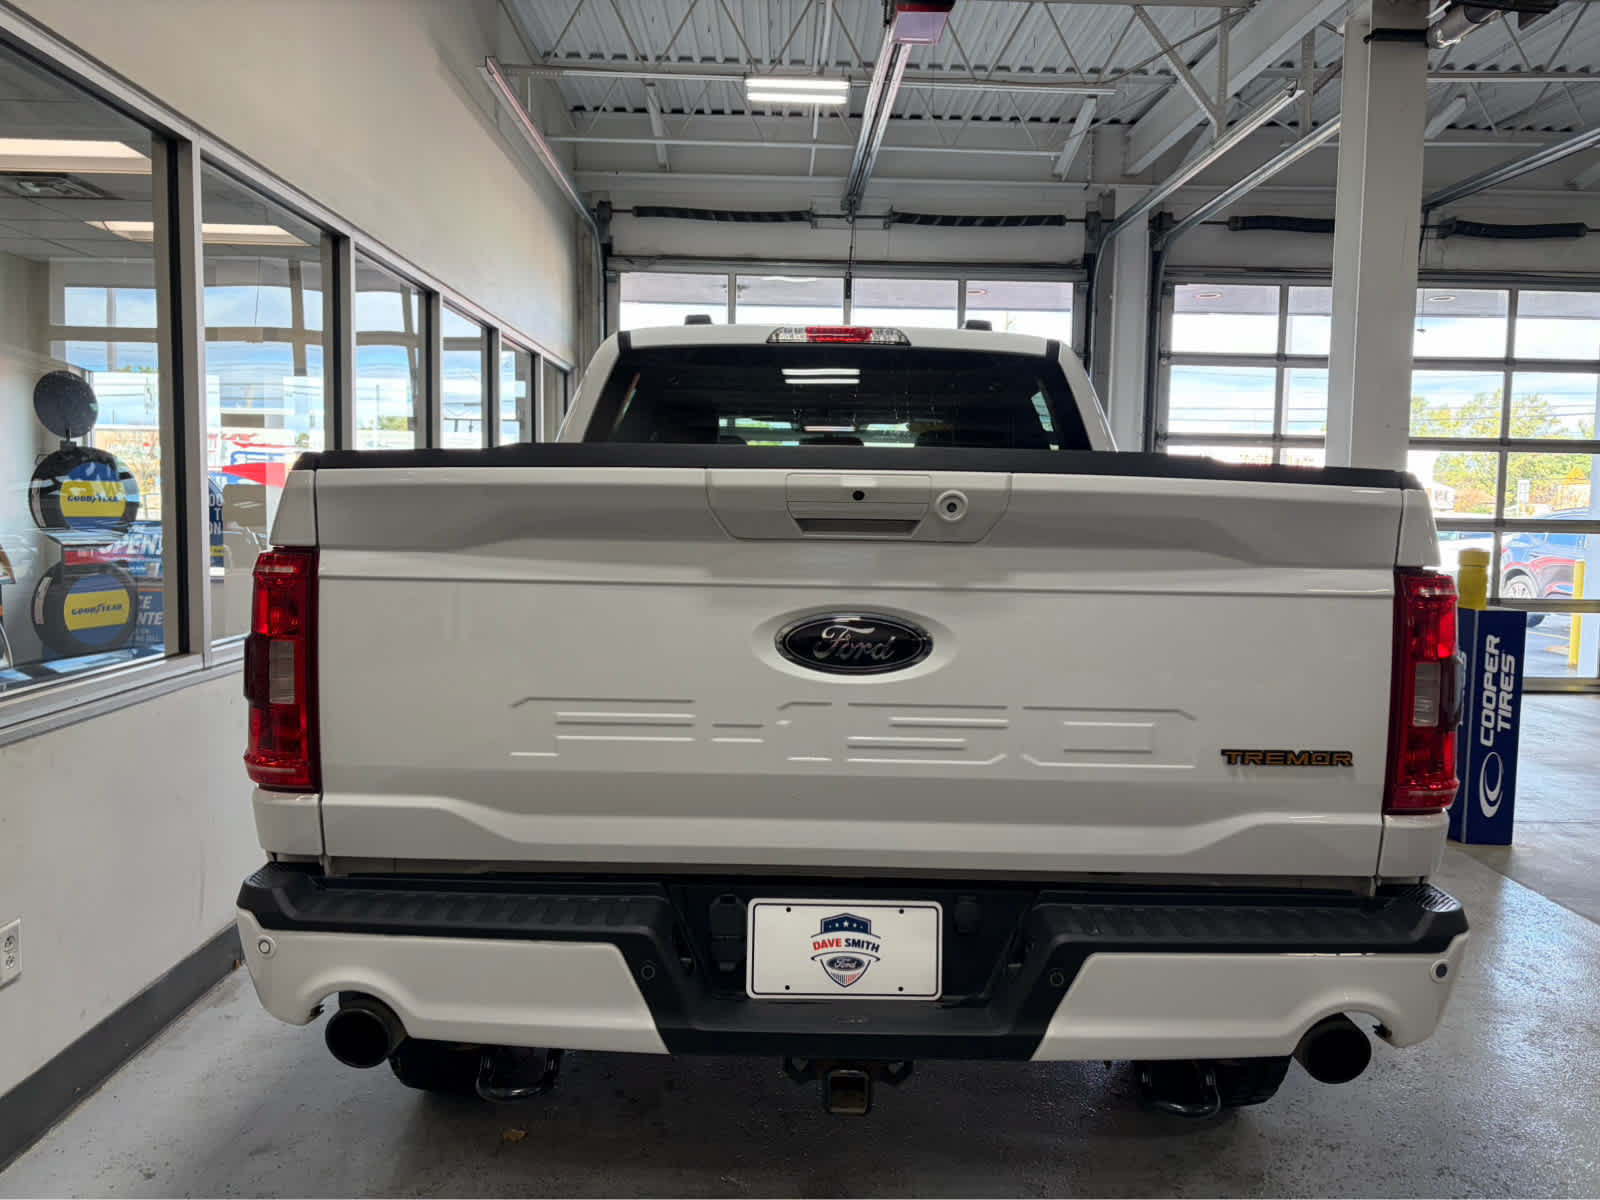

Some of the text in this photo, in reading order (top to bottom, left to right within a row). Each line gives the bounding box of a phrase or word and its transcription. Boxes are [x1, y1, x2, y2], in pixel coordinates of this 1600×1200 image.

[67, 494, 119, 504] GOODYEAR
[71, 602, 123, 616] GOODYEAR
[813, 624, 897, 660] Ford
[1480, 634, 1500, 747] COOPER
[1497, 653, 1515, 733] TIRES
[1221, 749, 1353, 767] TREMOR
[812, 937, 880, 953] DAVE SMITH
